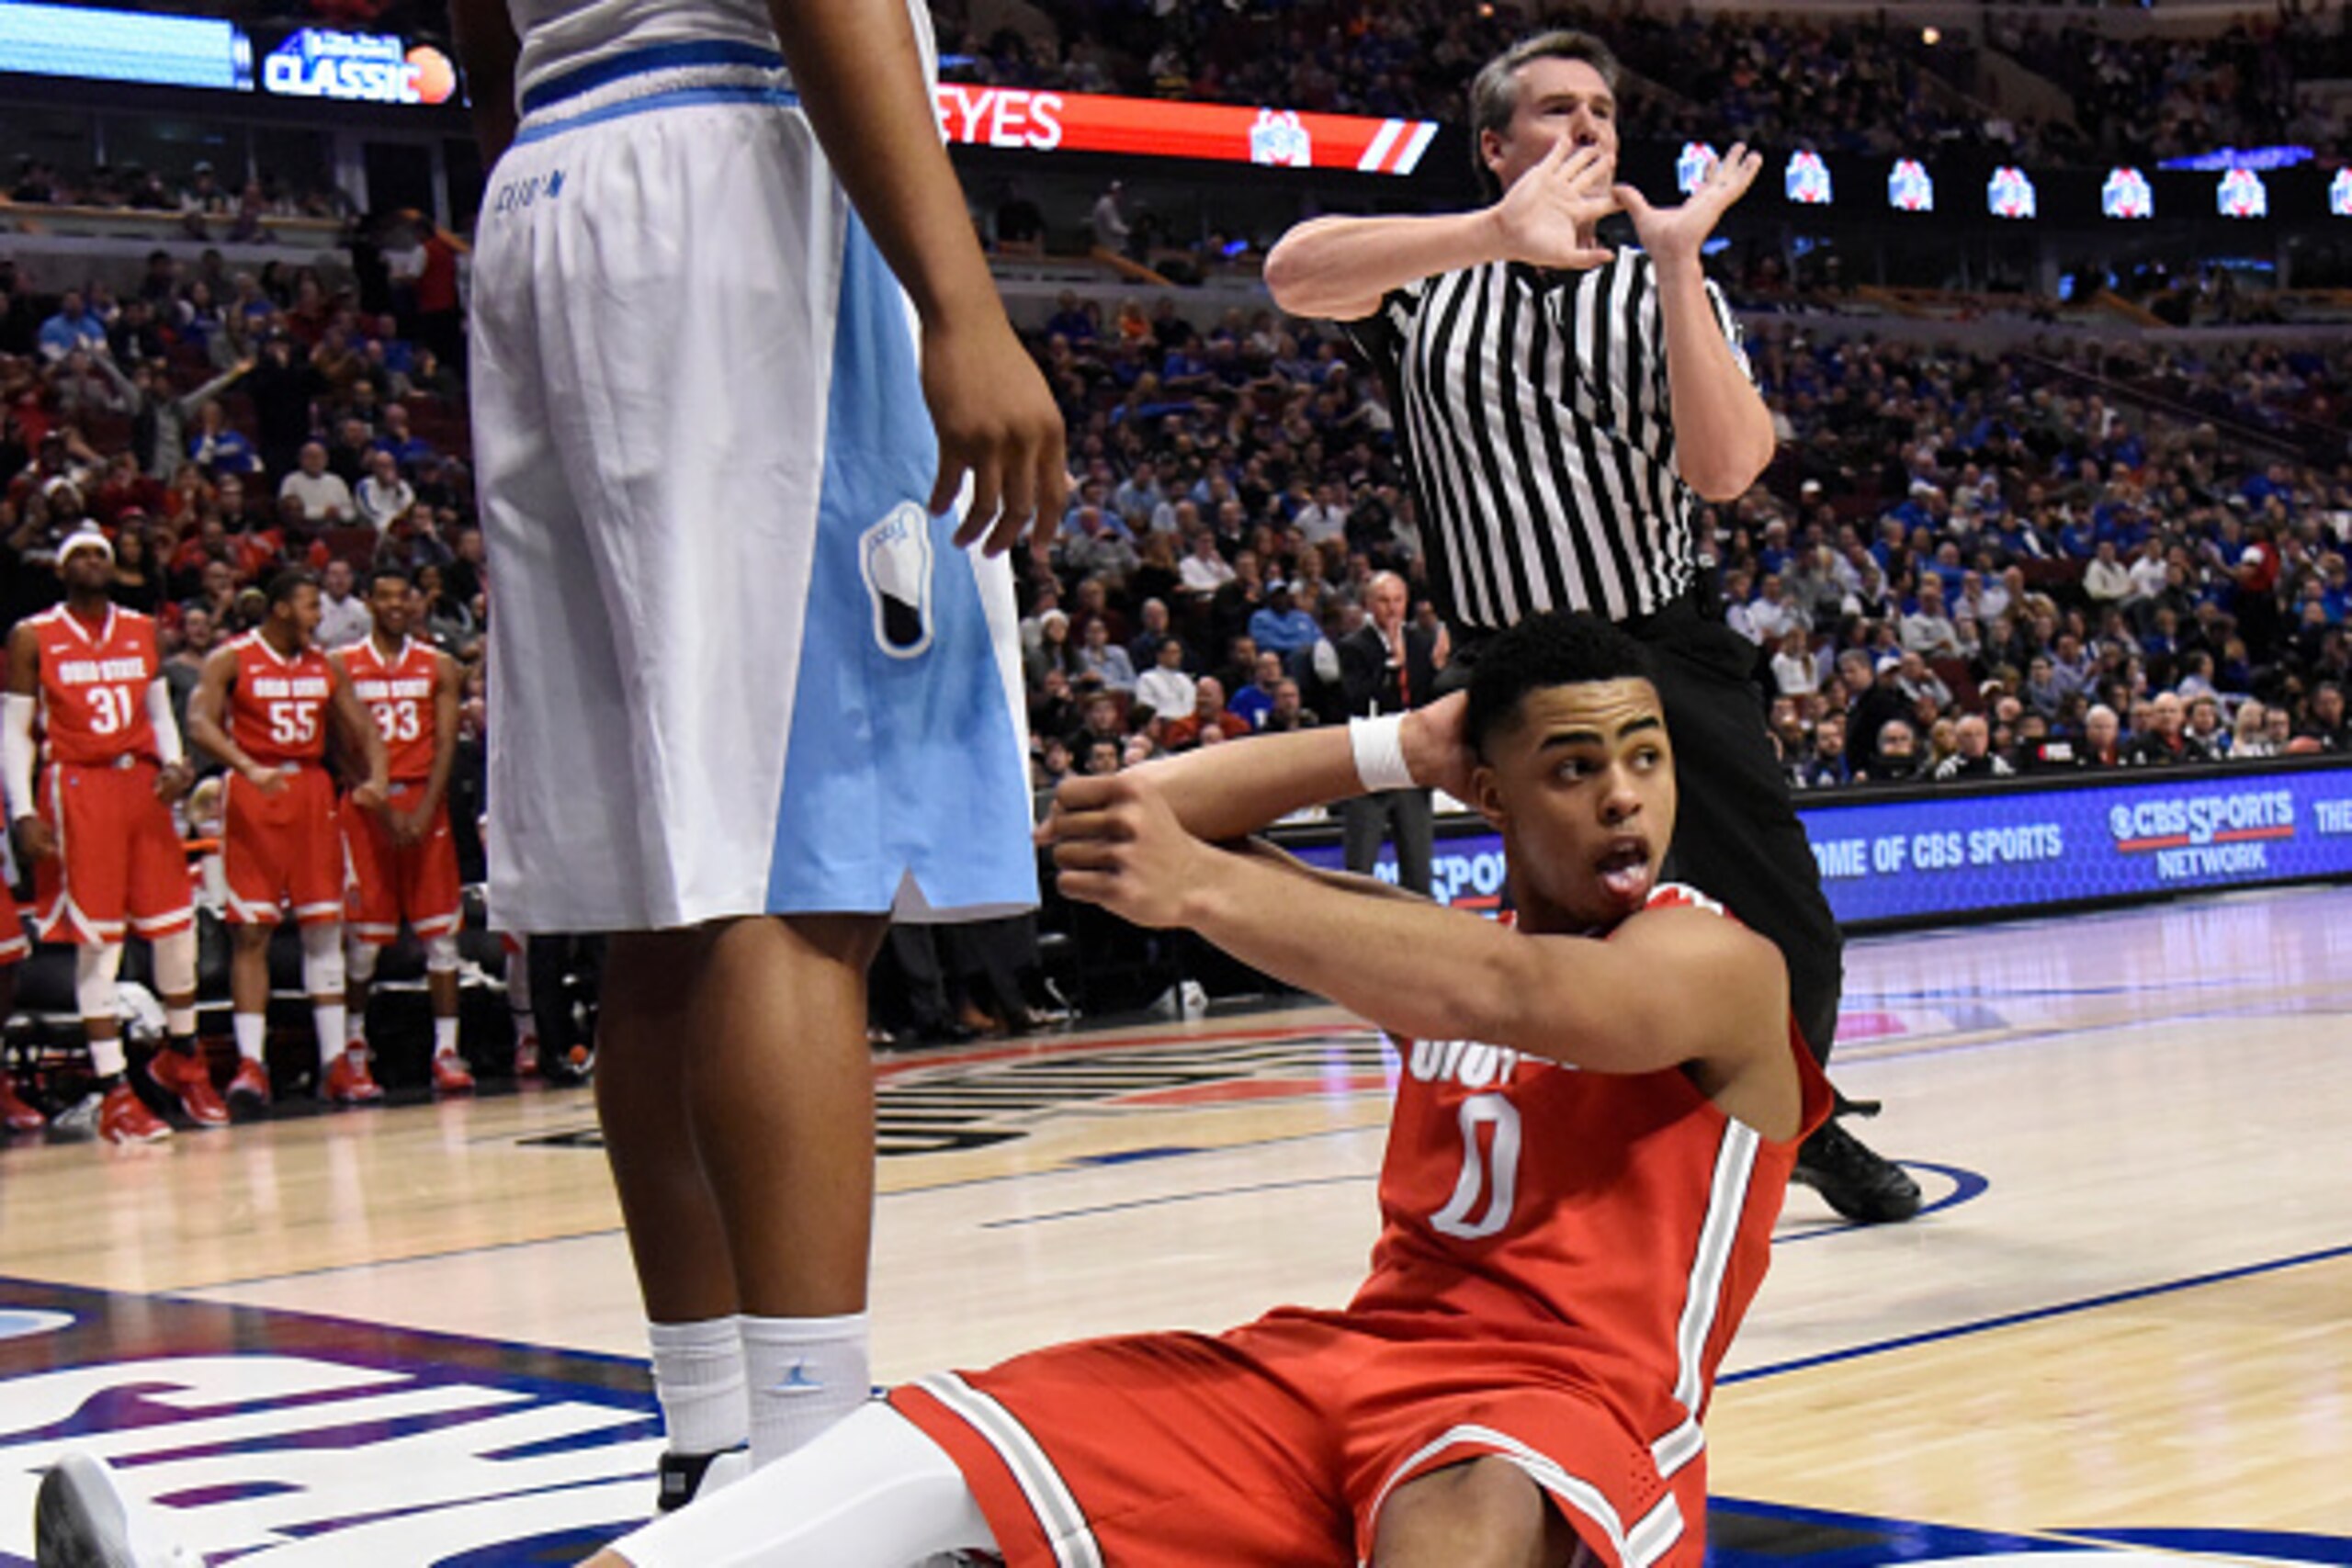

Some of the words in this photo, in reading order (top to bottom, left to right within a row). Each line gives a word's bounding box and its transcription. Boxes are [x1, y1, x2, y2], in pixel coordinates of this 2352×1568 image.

[265, 54, 421, 104] CLASSIC
[86, 684, 132, 735] 31
[269, 701, 320, 744] 55
[370, 700, 420, 742] 33
[1872, 835, 1906, 873] OF
[1912, 830, 1963, 869] CBS
[1968, 823, 2064, 865] SPORTS
[2156, 842, 2267, 879] NETWORK
[1429, 1091, 1521, 1239] 0
